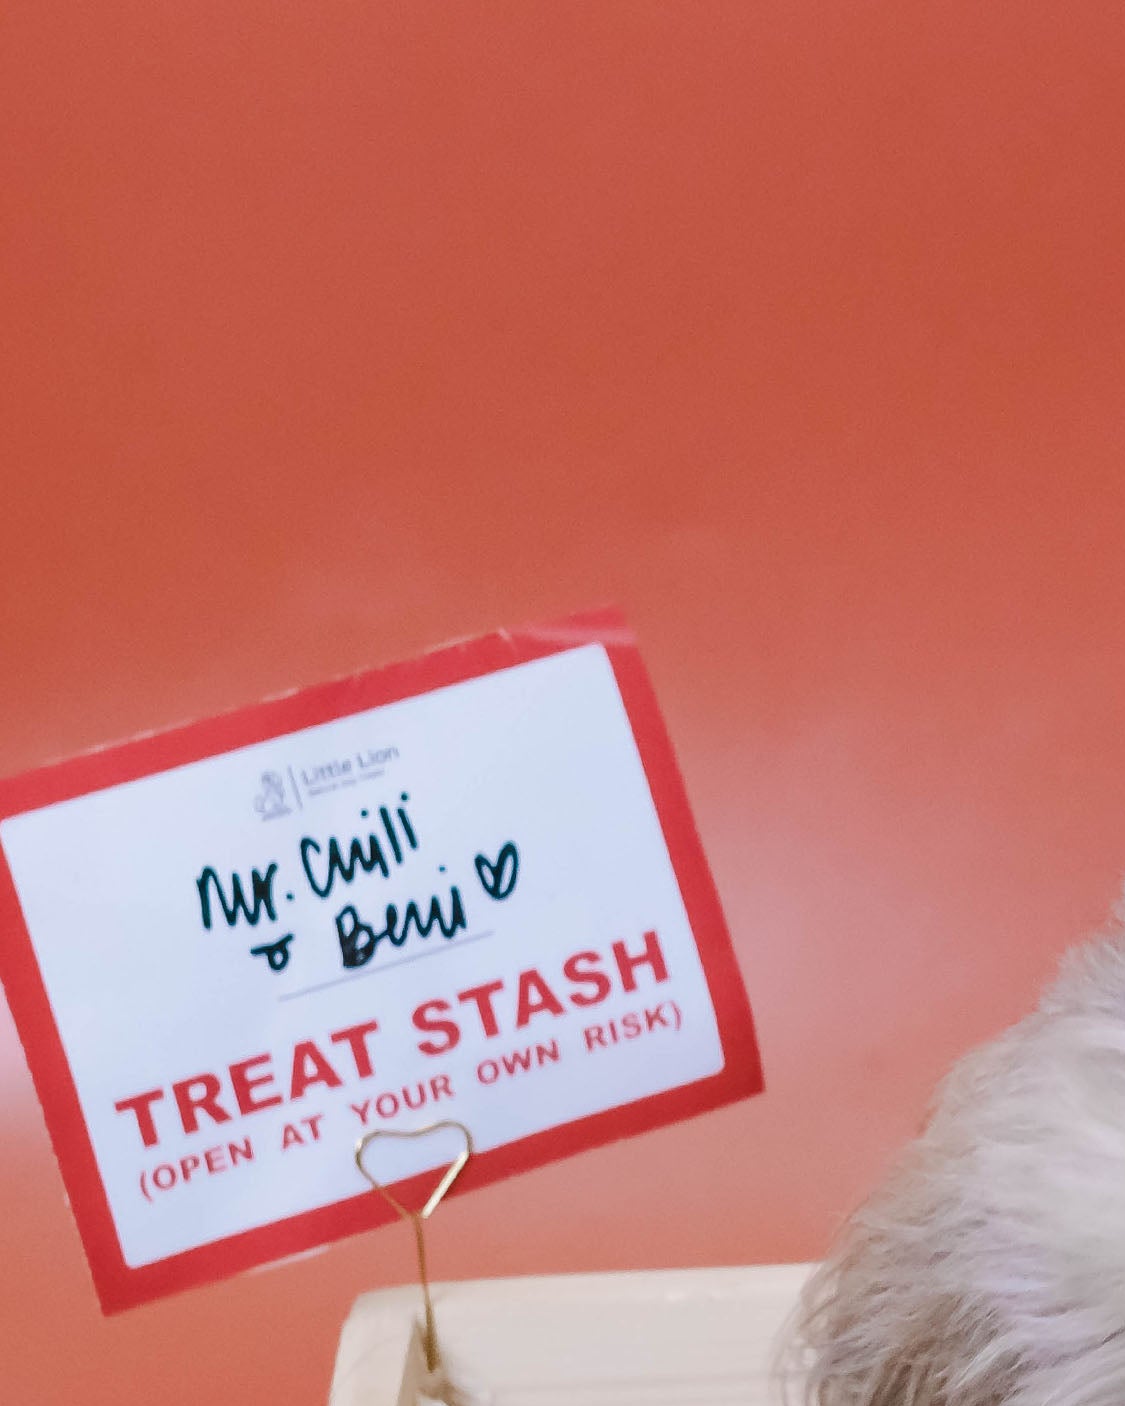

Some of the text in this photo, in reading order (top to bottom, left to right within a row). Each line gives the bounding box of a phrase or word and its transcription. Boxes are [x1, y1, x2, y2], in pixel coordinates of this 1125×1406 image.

[301, 759, 352, 785] Little
[357, 746, 400, 769] Lion
[196, 862, 294, 930] Mr.
[113, 928, 670, 1150] TREAT STASH
[139, 1000, 682, 1202] (OPEN AT YOUR OWN RISK)
